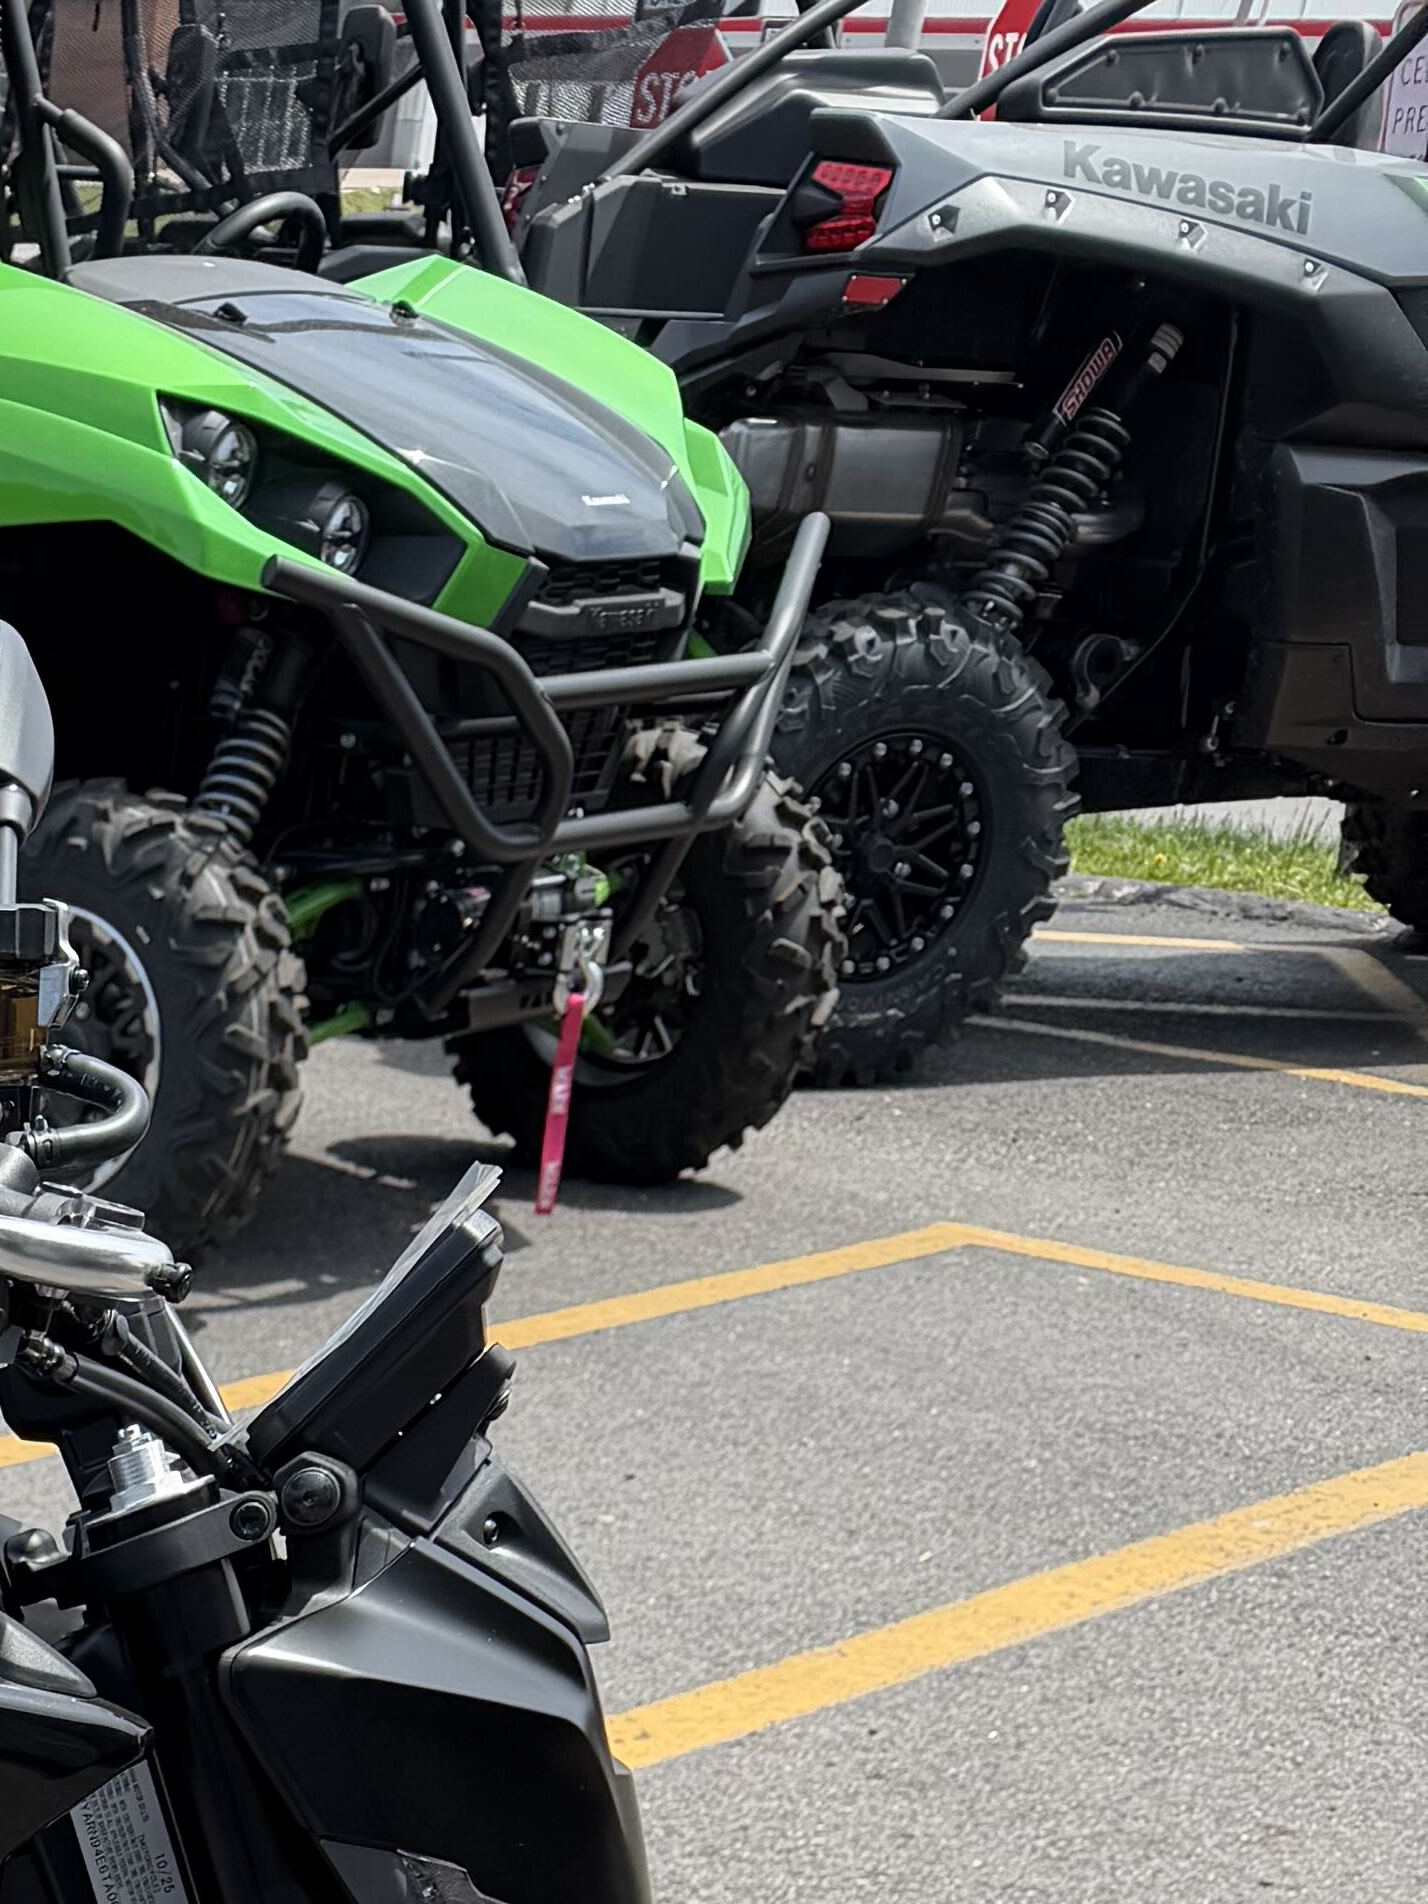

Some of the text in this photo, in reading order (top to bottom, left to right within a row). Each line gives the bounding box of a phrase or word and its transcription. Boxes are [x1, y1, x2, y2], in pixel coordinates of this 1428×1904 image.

[988, 32, 1028, 71] ST
[1401, 56, 1428, 86] CE
[636, 70, 697, 123] ST
[1063, 140, 1312, 236] Kawasaki
[154, 1853, 176, 1894] 10/25
